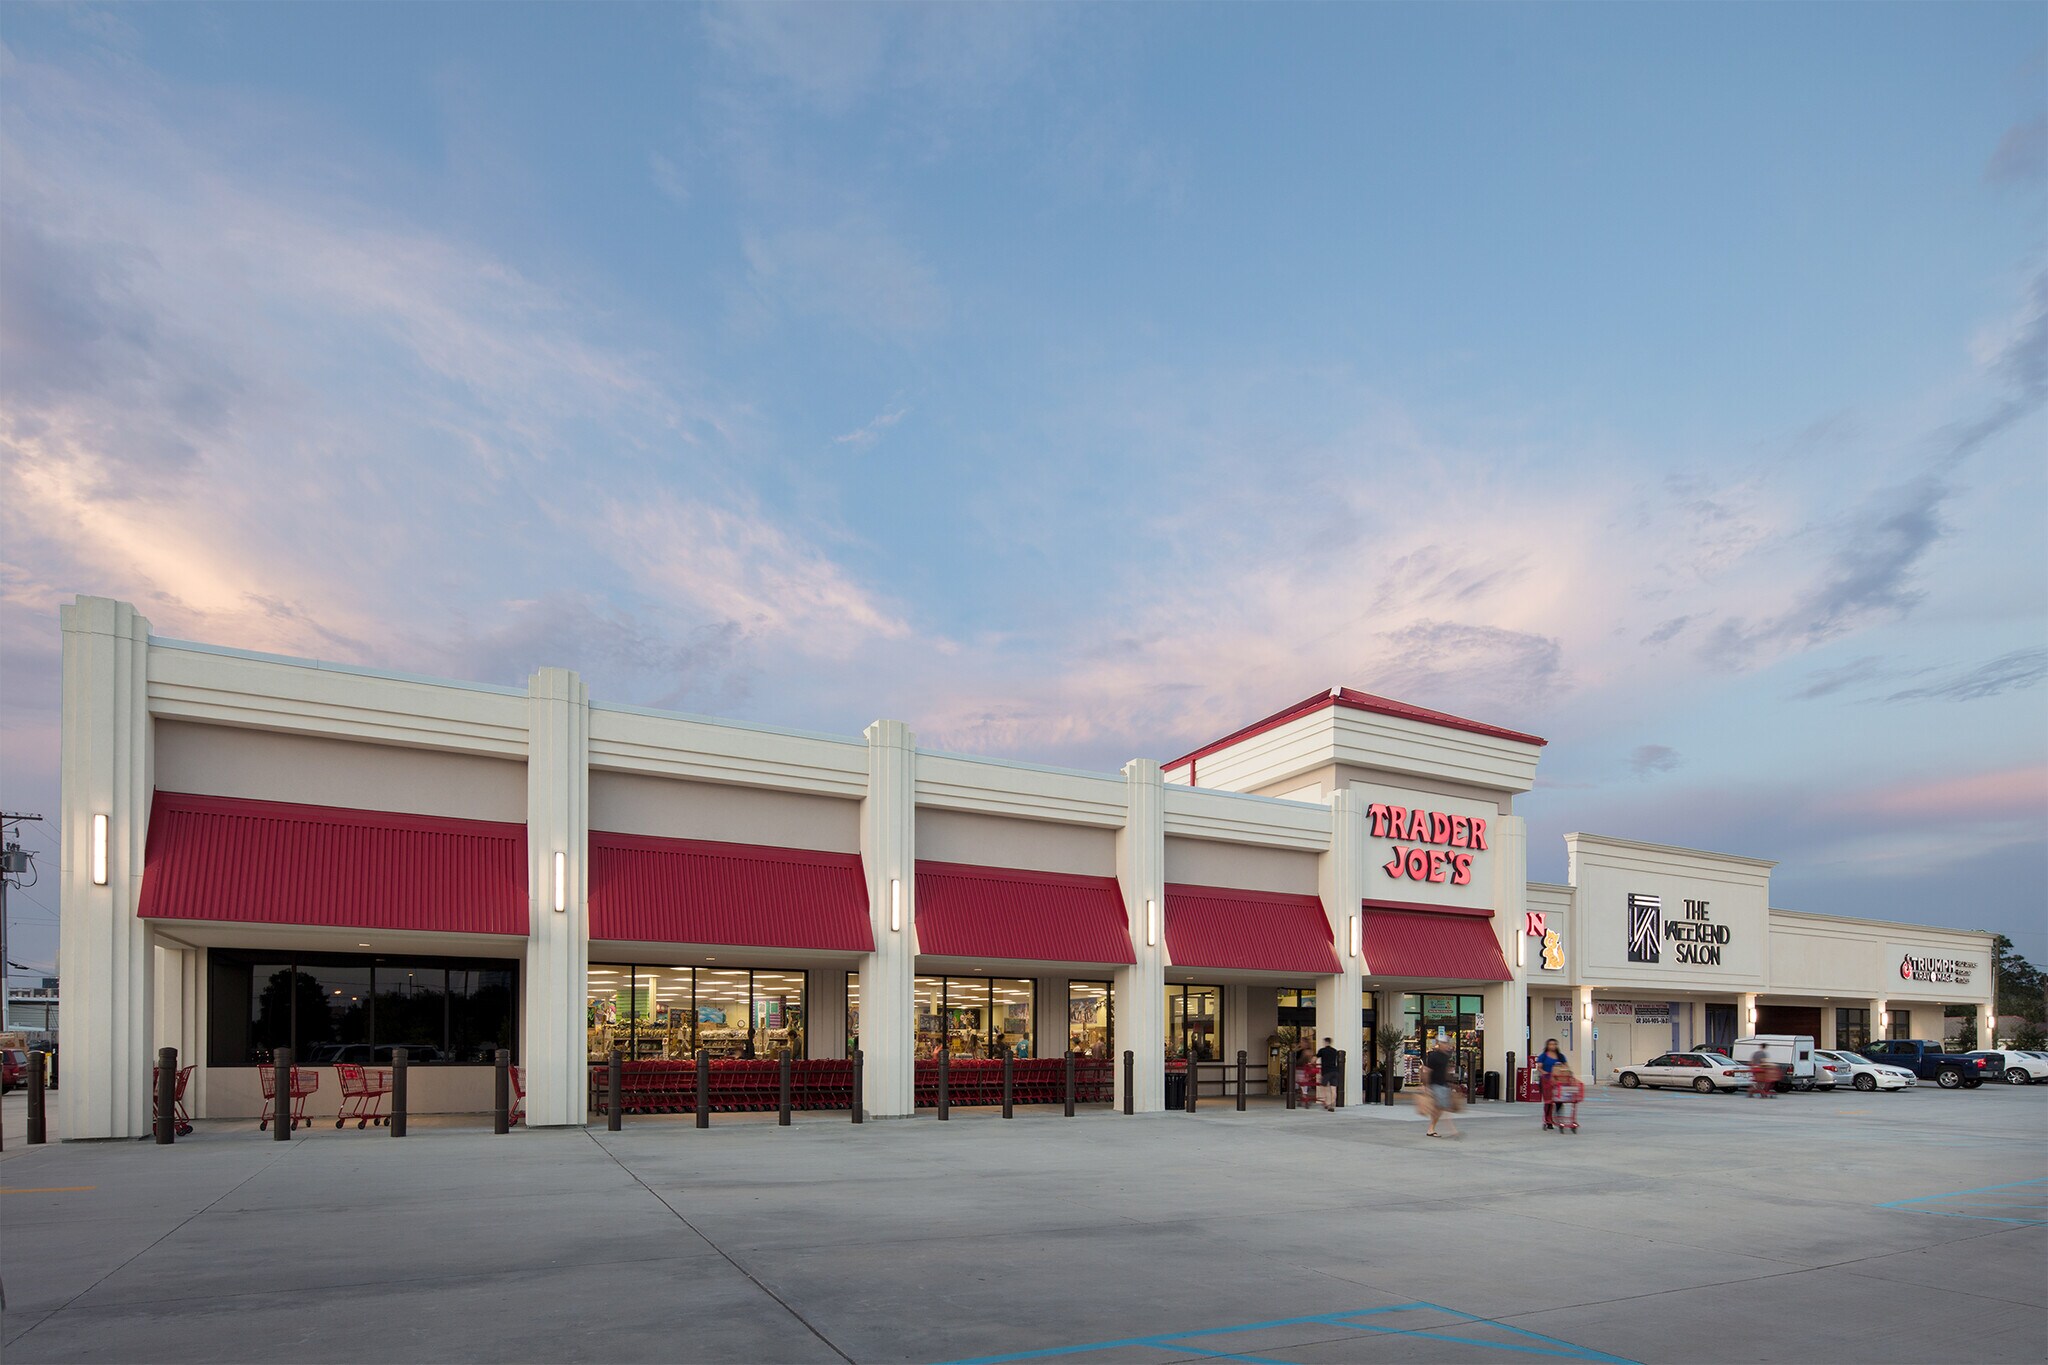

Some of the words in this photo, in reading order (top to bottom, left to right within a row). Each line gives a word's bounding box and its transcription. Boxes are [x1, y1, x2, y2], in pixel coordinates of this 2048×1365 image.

[1366, 803, 1488, 850] TRADER
[1382, 845, 1474, 885] JOE'S
[1682, 899, 1710, 921] THE
[1663, 919, 1731, 945] WEEKEND
[1675, 943, 1721, 966] SALON
[1911, 957, 1955, 973] TRIUMPH
[1597, 1003, 1618, 1015] COMING
[1618, 1004, 1633, 1015] SOON
